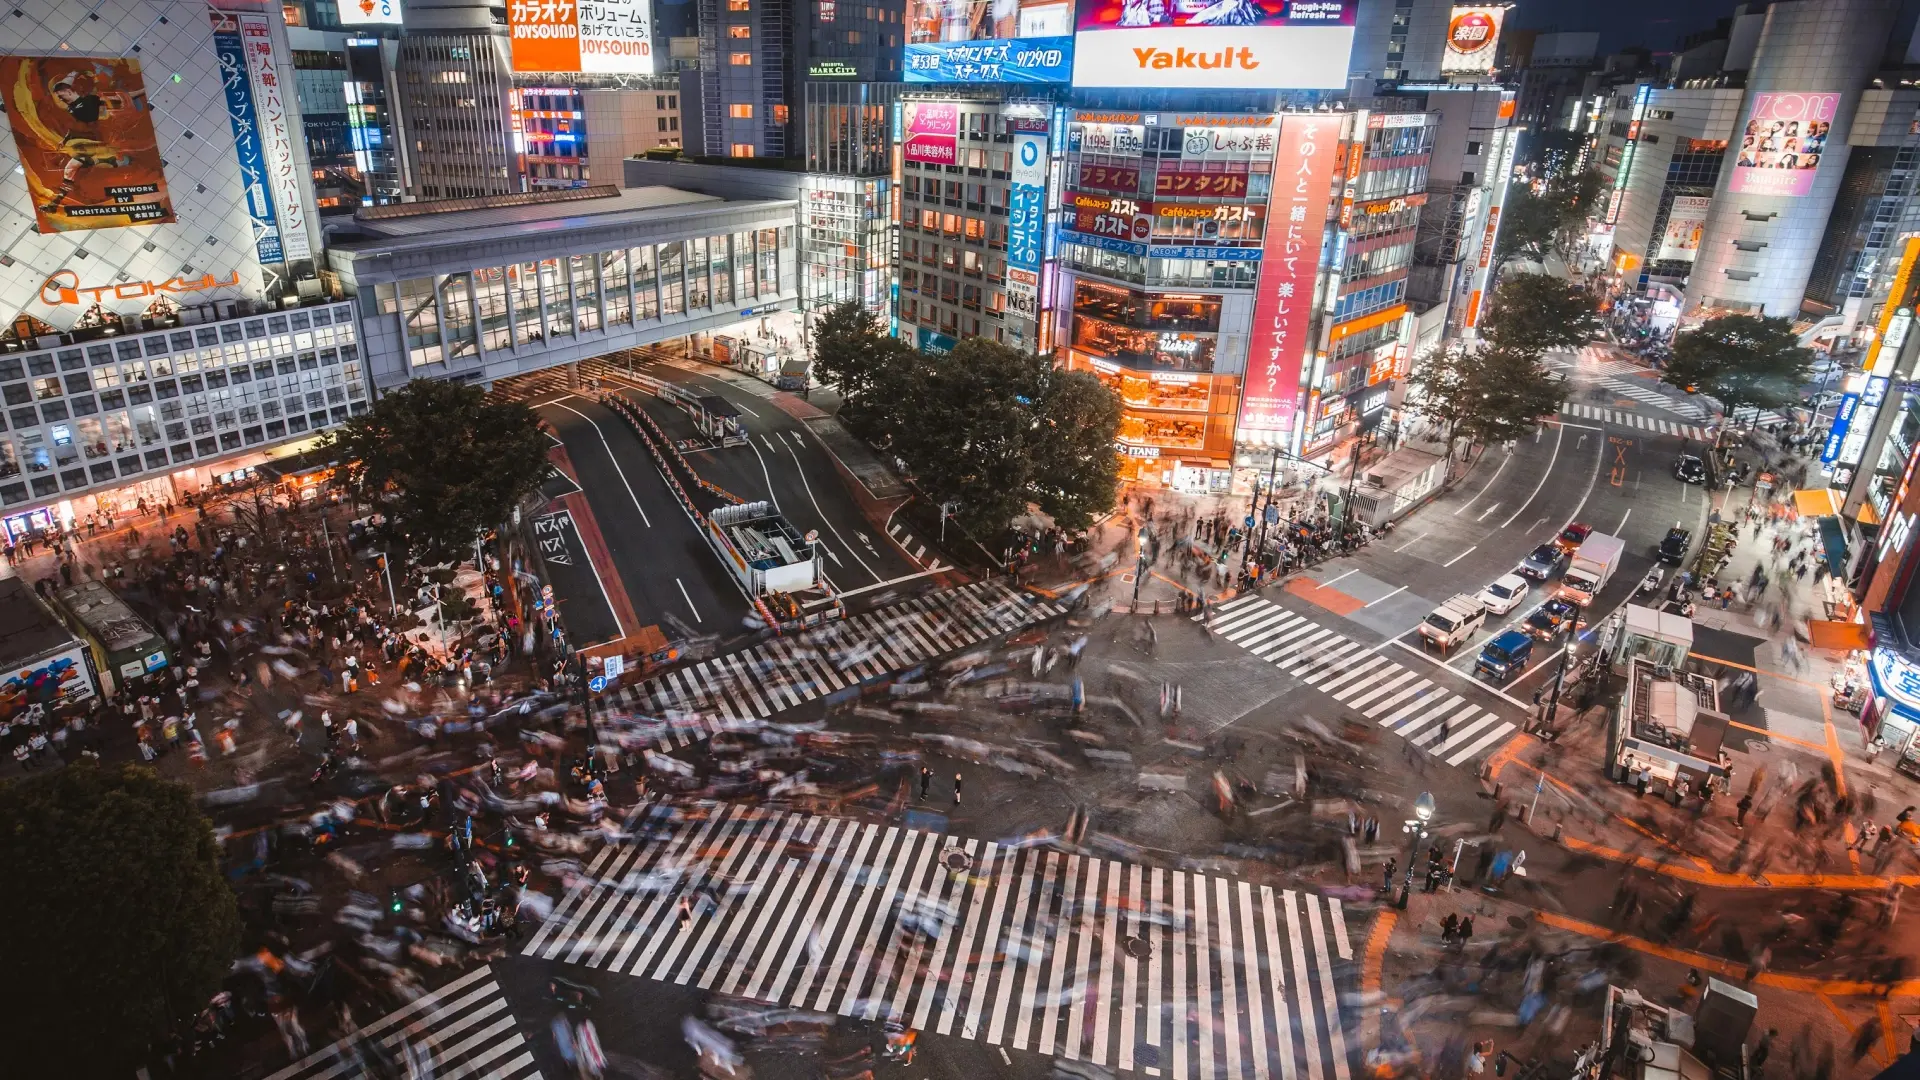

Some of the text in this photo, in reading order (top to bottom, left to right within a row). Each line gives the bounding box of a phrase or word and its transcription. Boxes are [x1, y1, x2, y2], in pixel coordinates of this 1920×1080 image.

[512, 1, 573, 23] カラオケ
[580, 5, 648, 25] ボリューム、
[1290, 10, 1325, 19] Refresh
[1291, 2, 1341, 12] Tough-Man
[514, 24, 577, 39] JOYSOUND
[582, 24, 649, 39] あげていこう。
[582, 40, 649, 56] JOYSOUND
[946, 42, 1012, 63] スプリンターズ
[911, 54, 940, 70] 第53回
[1017, 49, 1062, 68] 9/29(日)
[1132, 47, 1260, 70] Yakult
[835, 66, 856, 74] CITY
[954, 63, 1002, 79] ステークス
[926, 109, 955, 119] 品川スキン
[1075, 111, 1139, 124] しゃぶしゃぶバイキング
[1176, 115, 1275, 127] しゃぶしゃぶバイキング
[926, 120, 952, 130] クリニック
[1018, 120, 1045, 130] 当ビル5F
[256, 42, 302, 230] 婦人靴・ハンドバッグバーゲン
[1070, 131, 1081, 142] 9F
[1214, 134, 1272, 151] しゃぶ葉
[911, 144, 953, 159] 品川美容外科
[1016, 168, 1041, 180] eyecity
[1081, 167, 1138, 187] プライス
[111, 185, 154, 194] ARTWORK
[1157, 175, 1244, 192] コンタクト
[71, 204, 156, 215] NORITAKE KINASHI
[1110, 200, 1140, 216] ガスト
[1161, 205, 1256, 221] Caféレストラン ガスト
[1064, 212, 1076, 223] 7F
[1094, 214, 1129, 236] ガスト
[1080, 236, 1131, 252] 英会話イーオン
[1154, 248, 1179, 257] AEON
[1184, 247, 1260, 259] 英会話イーオン
[1265, 124, 1318, 392] その人と一緒にいて、楽しいですか？
[77, 271, 239, 303] TOKYU
[1007, 290, 1035, 314] No.1
[1364, 392, 1387, 410] LUSH
